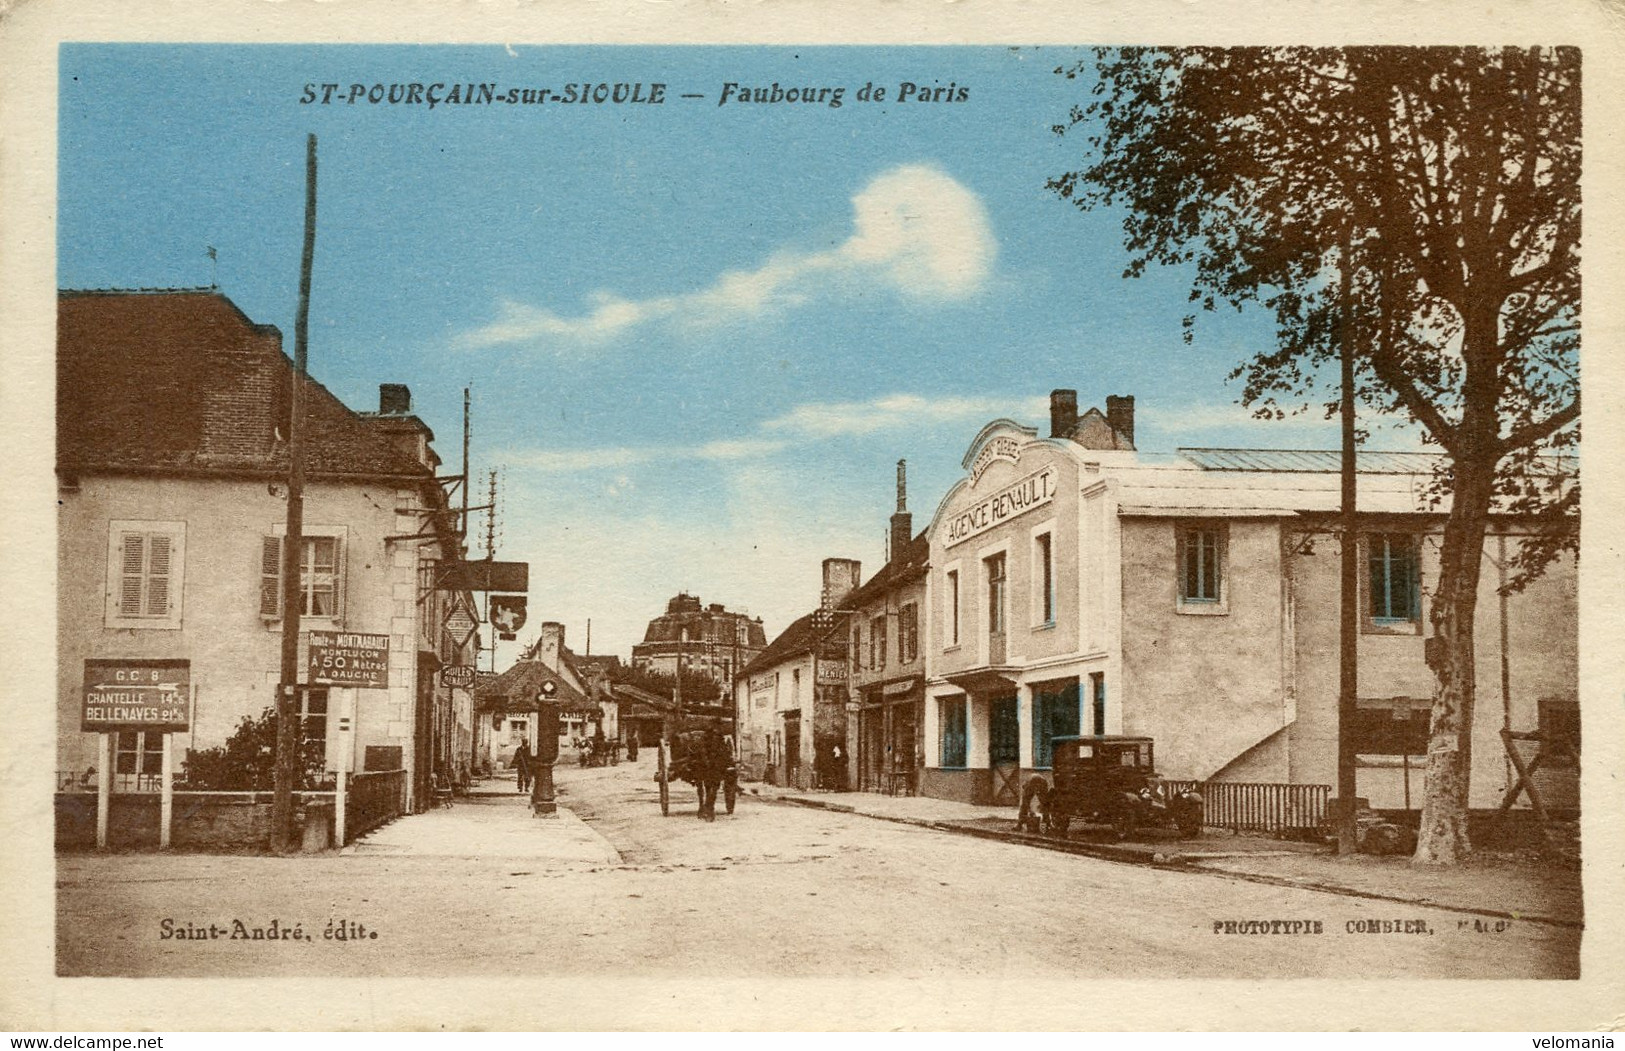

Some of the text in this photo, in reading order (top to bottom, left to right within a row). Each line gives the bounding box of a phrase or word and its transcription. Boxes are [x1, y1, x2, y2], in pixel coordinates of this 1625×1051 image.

[948, 472, 1050, 541] AGENCE RENAULT
[323, 656, 346, 668] 50
[151, 671, 159, 681] 8
[332, 671, 378, 679] GAUCHE
[87, 693, 145, 704] CHANTELLE
[87, 708, 158, 721] BELLENAVES
